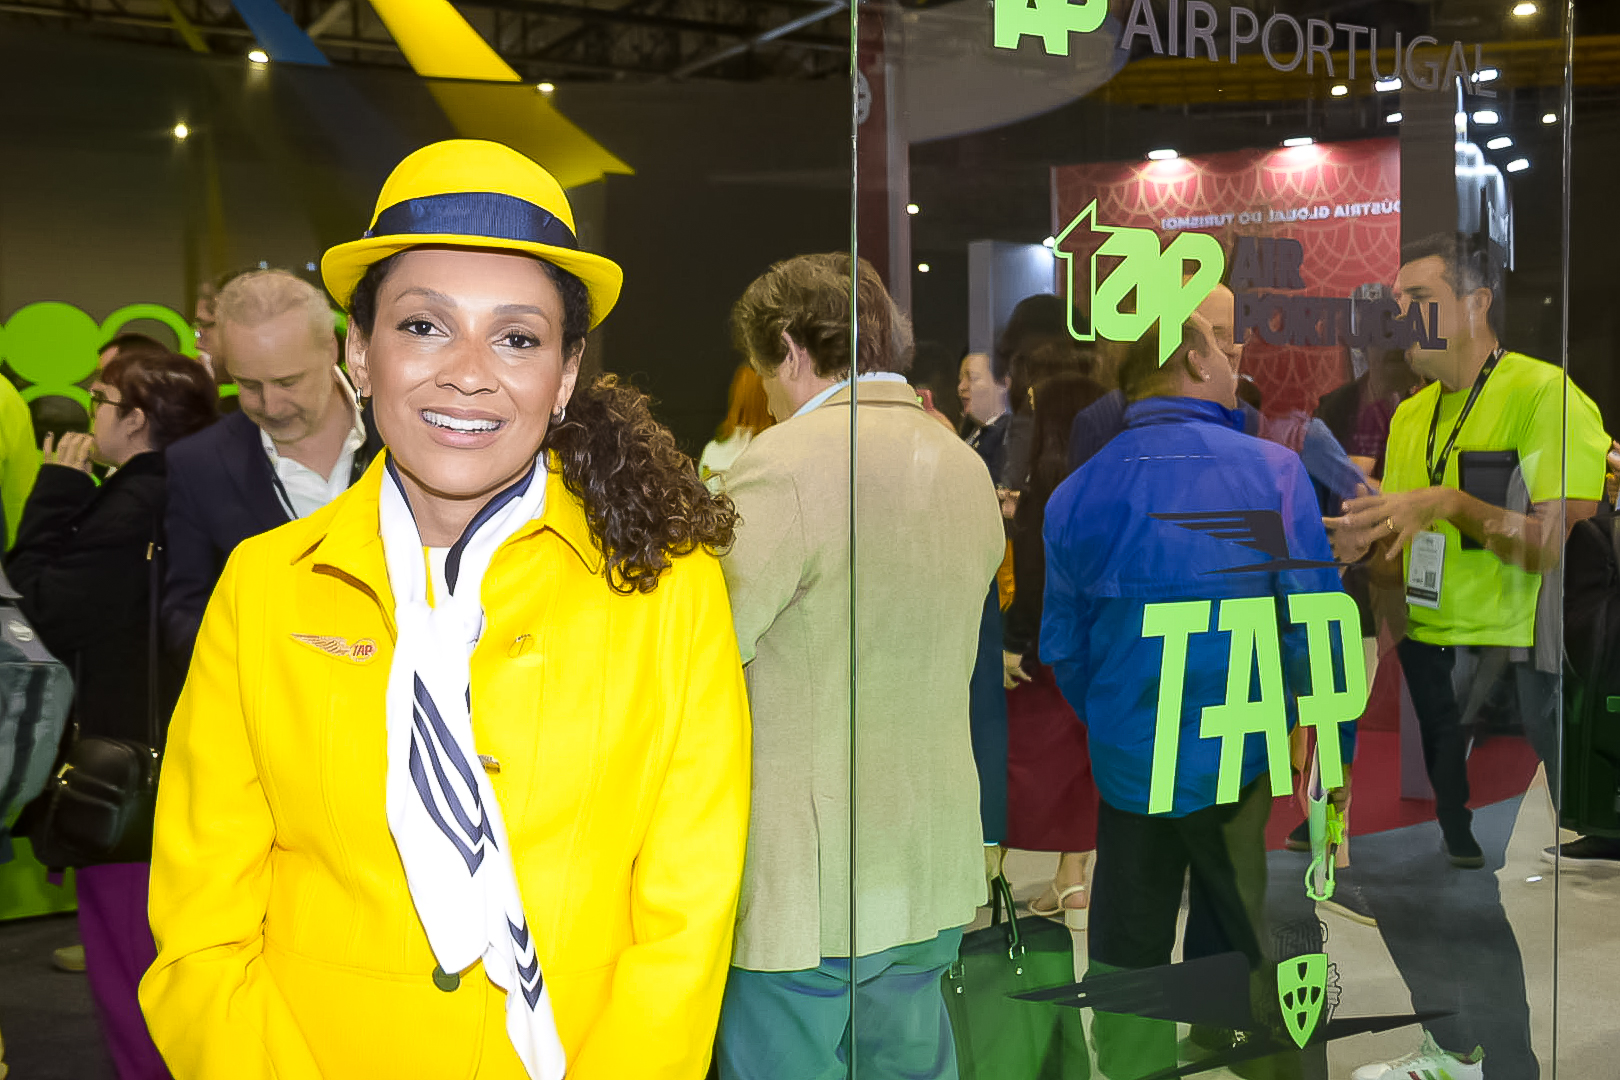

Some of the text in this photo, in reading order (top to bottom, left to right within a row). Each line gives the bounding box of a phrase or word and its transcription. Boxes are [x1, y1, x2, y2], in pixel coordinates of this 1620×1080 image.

[1119, 0, 1219, 62] AIR
[1229, 6, 1497, 98] PORTUGAL
[1229, 236, 1305, 289] AIR
[1232, 293, 1447, 352] PORTUGAL
[1142, 592, 1368, 814] TAP
